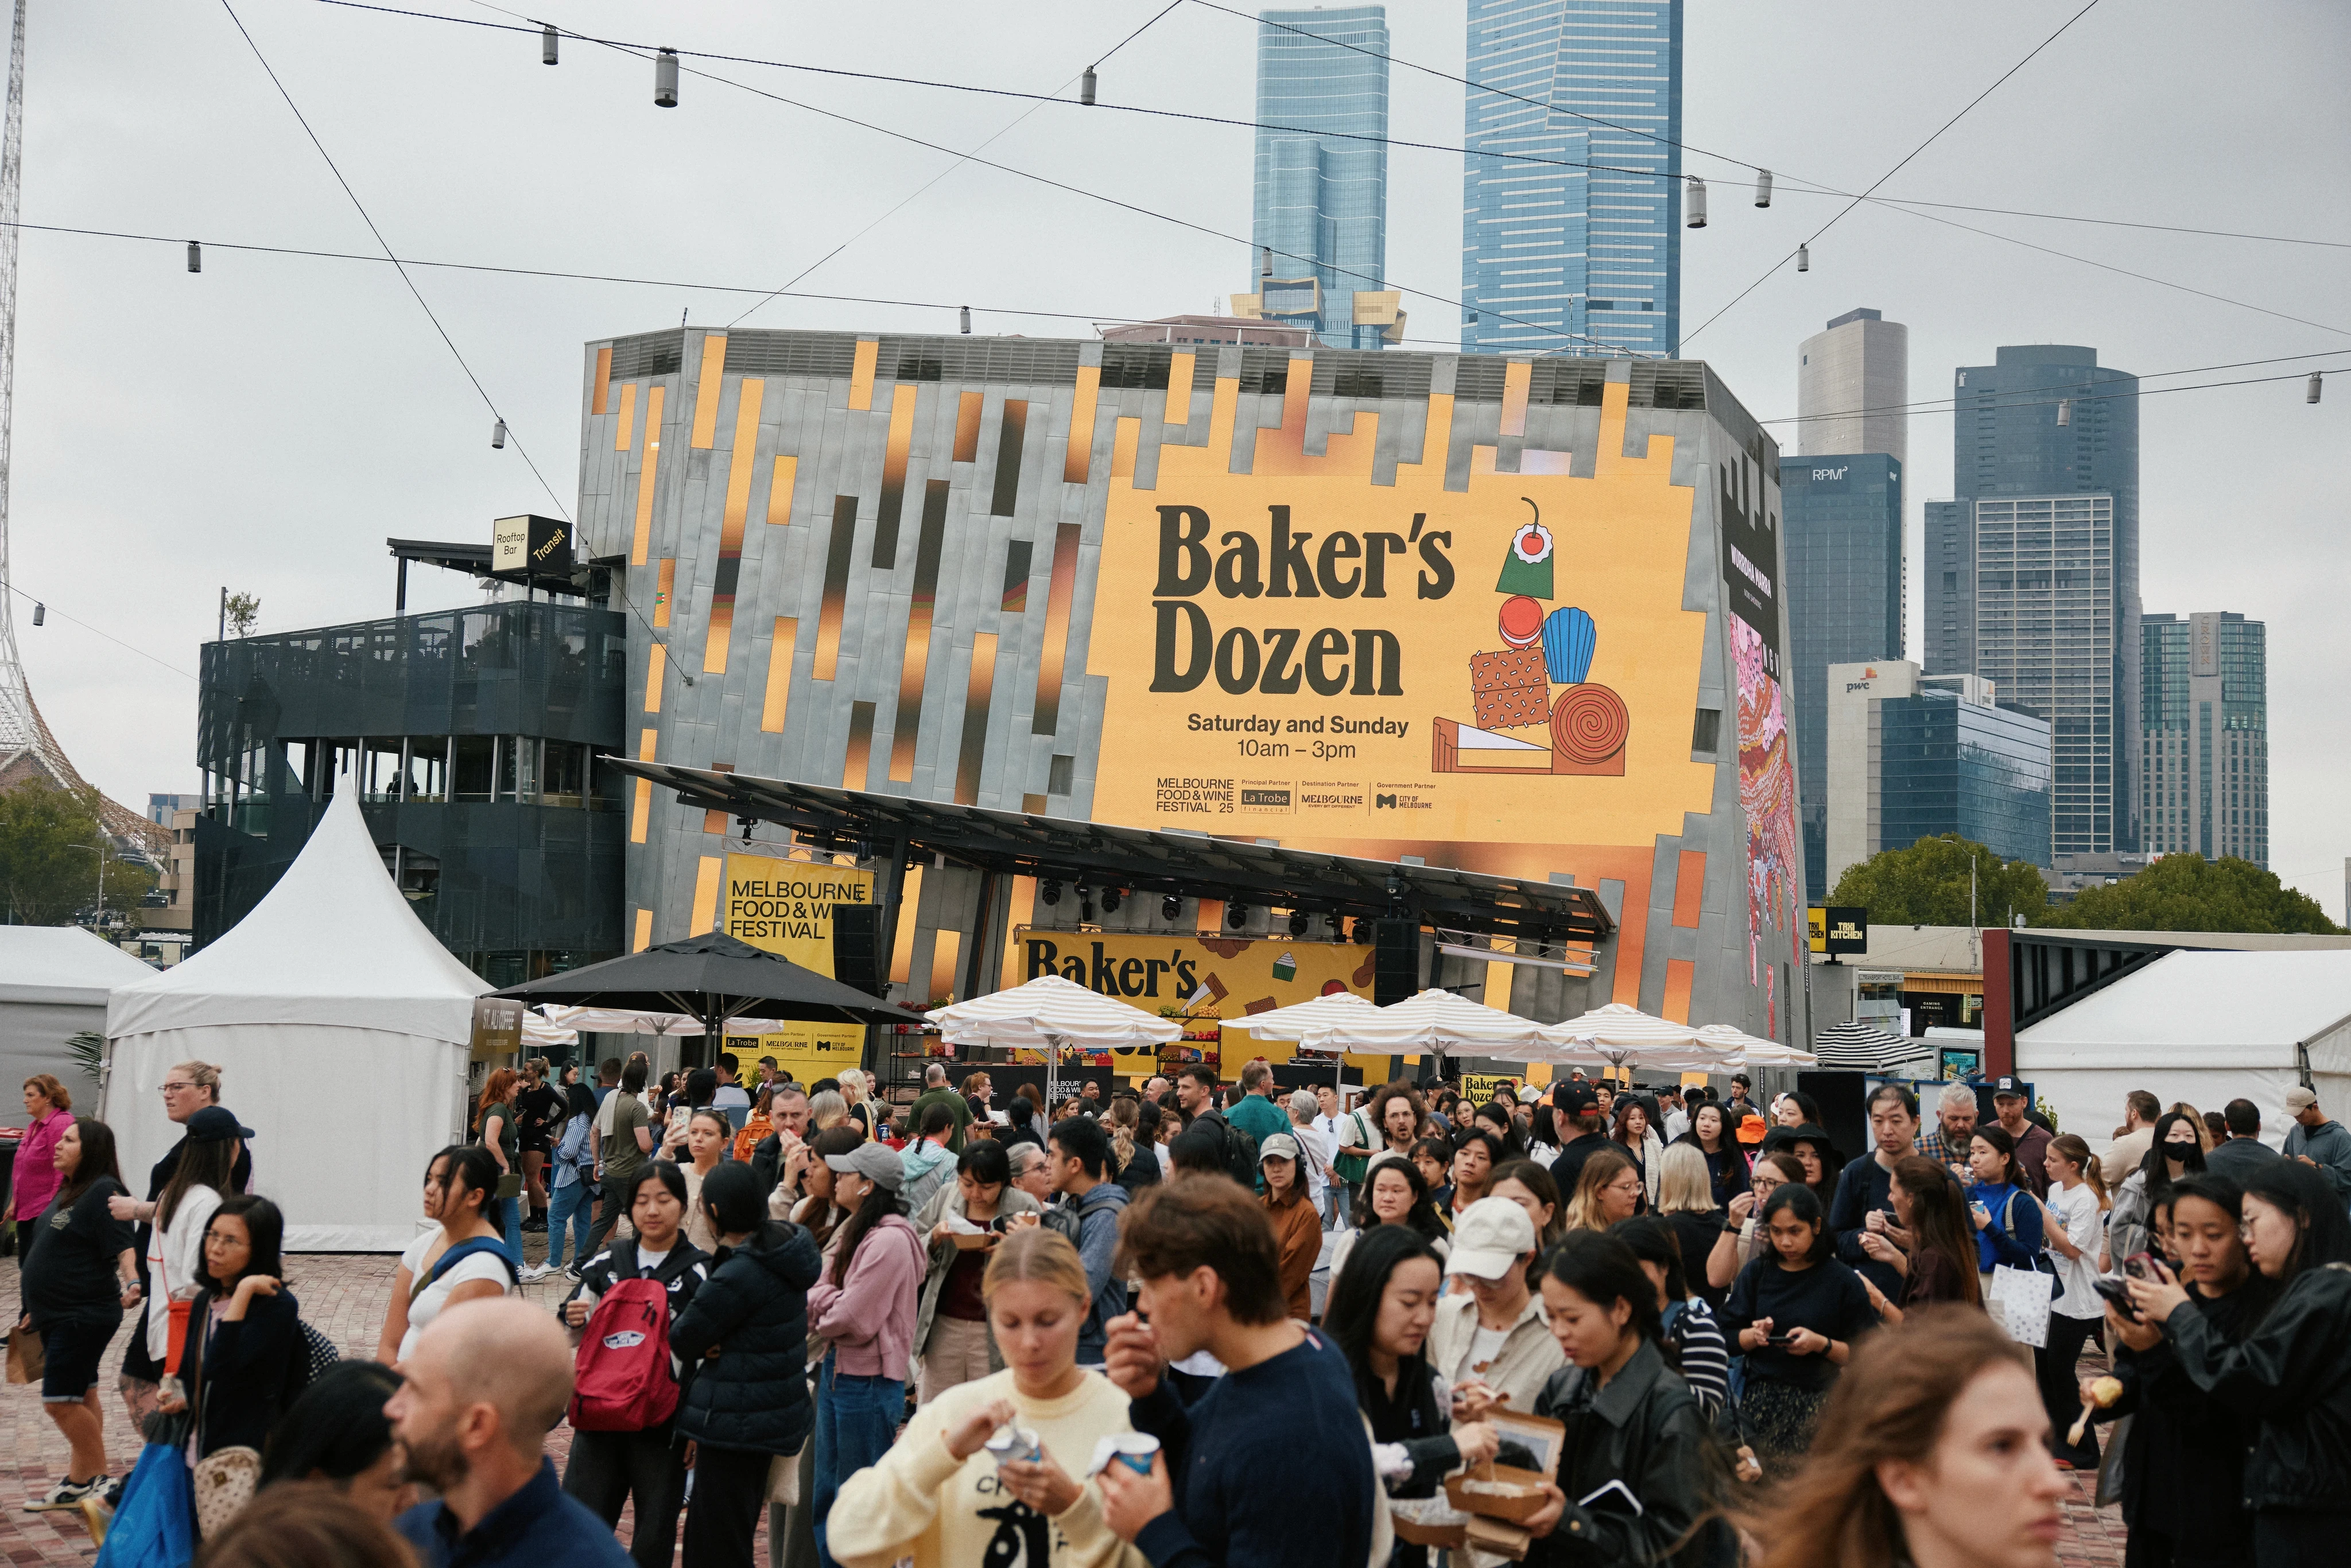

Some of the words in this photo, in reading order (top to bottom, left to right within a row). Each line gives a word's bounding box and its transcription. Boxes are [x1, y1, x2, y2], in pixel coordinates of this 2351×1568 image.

[497, 533, 525, 544] Rooftop
[533, 528, 565, 561] Transit
[504, 546, 517, 555] Bar
[1153, 505, 1455, 600] Baker's
[1731, 543, 1755, 584] WURRDHA
[1755, 566, 1772, 599] MARRA
[2200, 616, 2210, 665] CROWN
[1149, 600, 1403, 696] Dozen
[1846, 682, 1869, 693] pwc
[1187, 713, 1281, 736] Saturday
[1286, 716, 1324, 733] and
[1330, 716, 1409, 738] Sunday
[1237, 739, 1289, 757] 10am
[1312, 740, 1356, 761] 3pm
[1157, 778, 1234, 789] MELBOURNE
[1157, 790, 1191, 800] FOOD
[1193, 790, 1201, 801] &
[1203, 790, 1234, 801] WINE
[1244, 793, 1255, 802] La
[1258, 793, 1287, 803] Trobe
[1301, 794, 1363, 804] MELBOURNE
[1157, 802, 1212, 813] FESTIVAL
[1219, 803, 1233, 813] 25
[732, 880, 866, 901] MELBOURNE
[731, 901, 790, 918] FOOD
[793, 902, 808, 919] &
[730, 920, 825, 940] FESTIVAL
[1809, 922, 1819, 930] TAXI
[1838, 922, 1855, 930] TAXI
[1809, 930, 1824, 938] TCHEN
[1830, 930, 1863, 940] KITCHEN
[1025, 939, 1198, 999] Baker's
[499, 1010, 515, 1030] COFFEE
